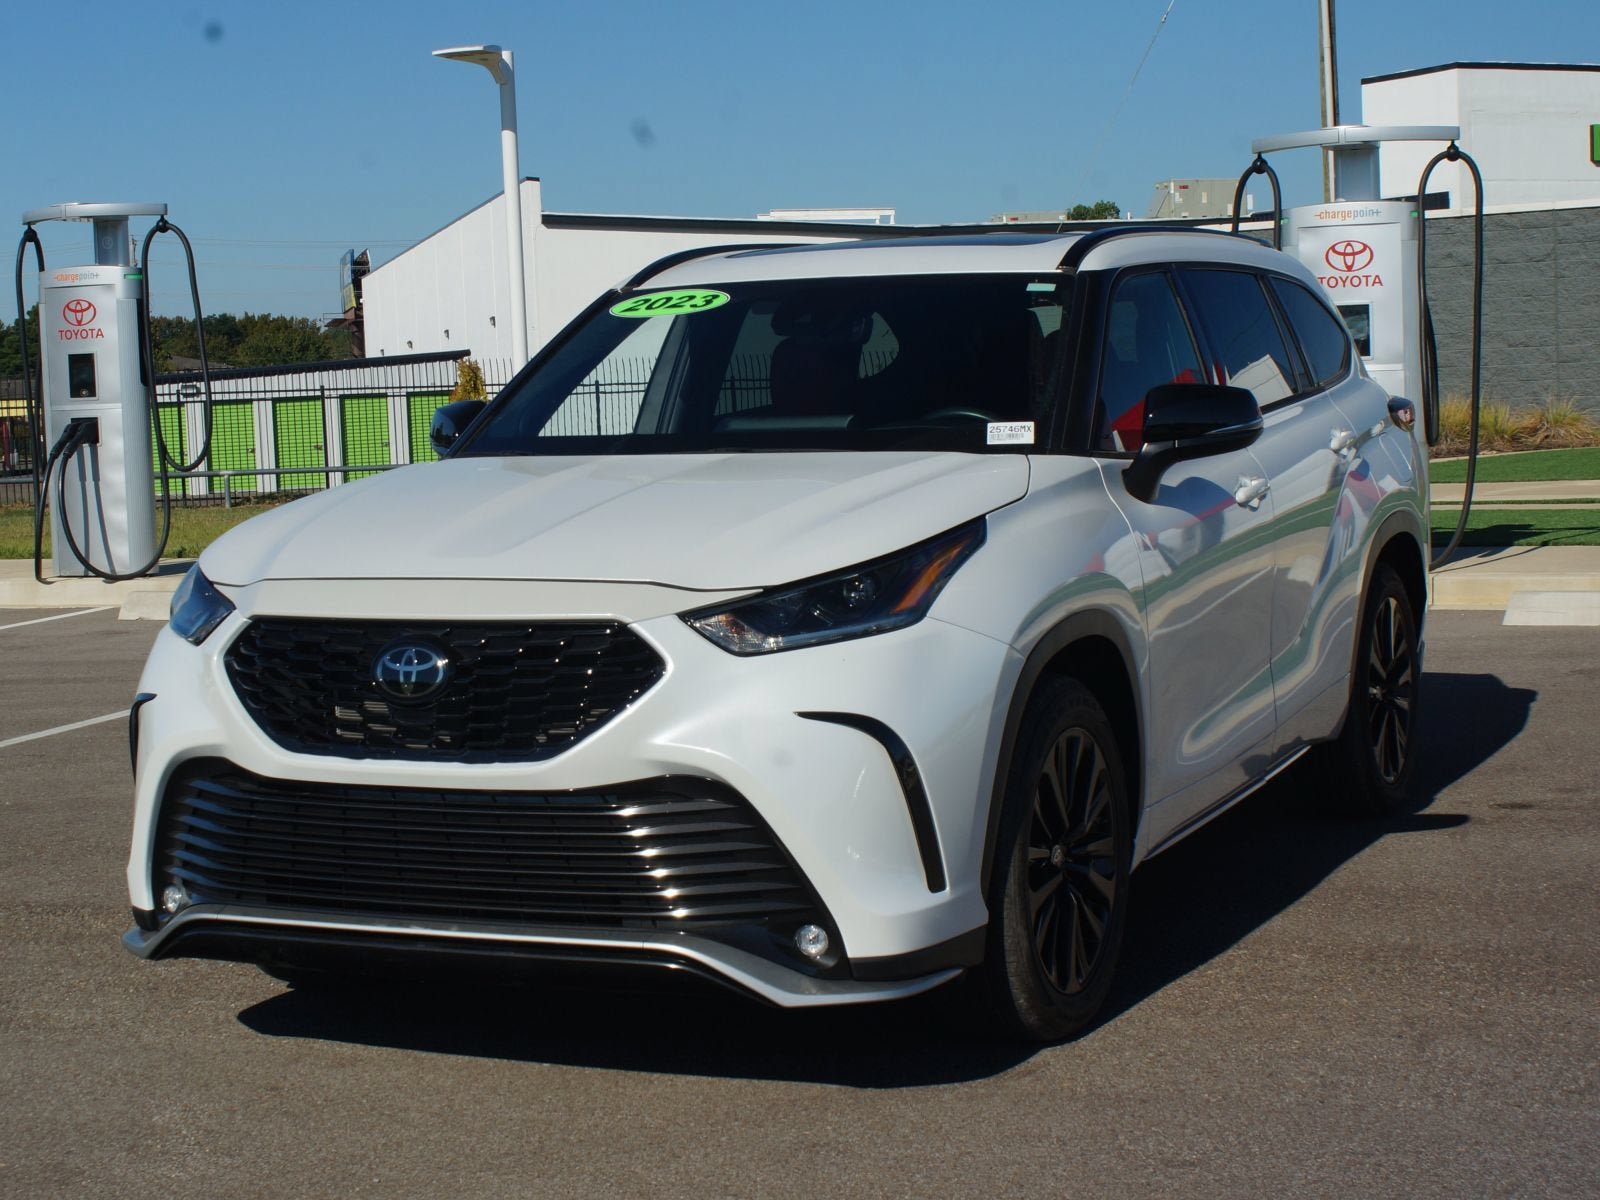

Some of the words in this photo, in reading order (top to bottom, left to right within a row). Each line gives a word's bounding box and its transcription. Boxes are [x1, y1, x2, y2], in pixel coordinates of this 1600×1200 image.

[1317, 274, 1384, 289] TOYOTA
[618, 293, 721, 314] 2023
[58, 328, 105, 341] TOYOTA
[989, 424, 1032, 434] 25746MX
